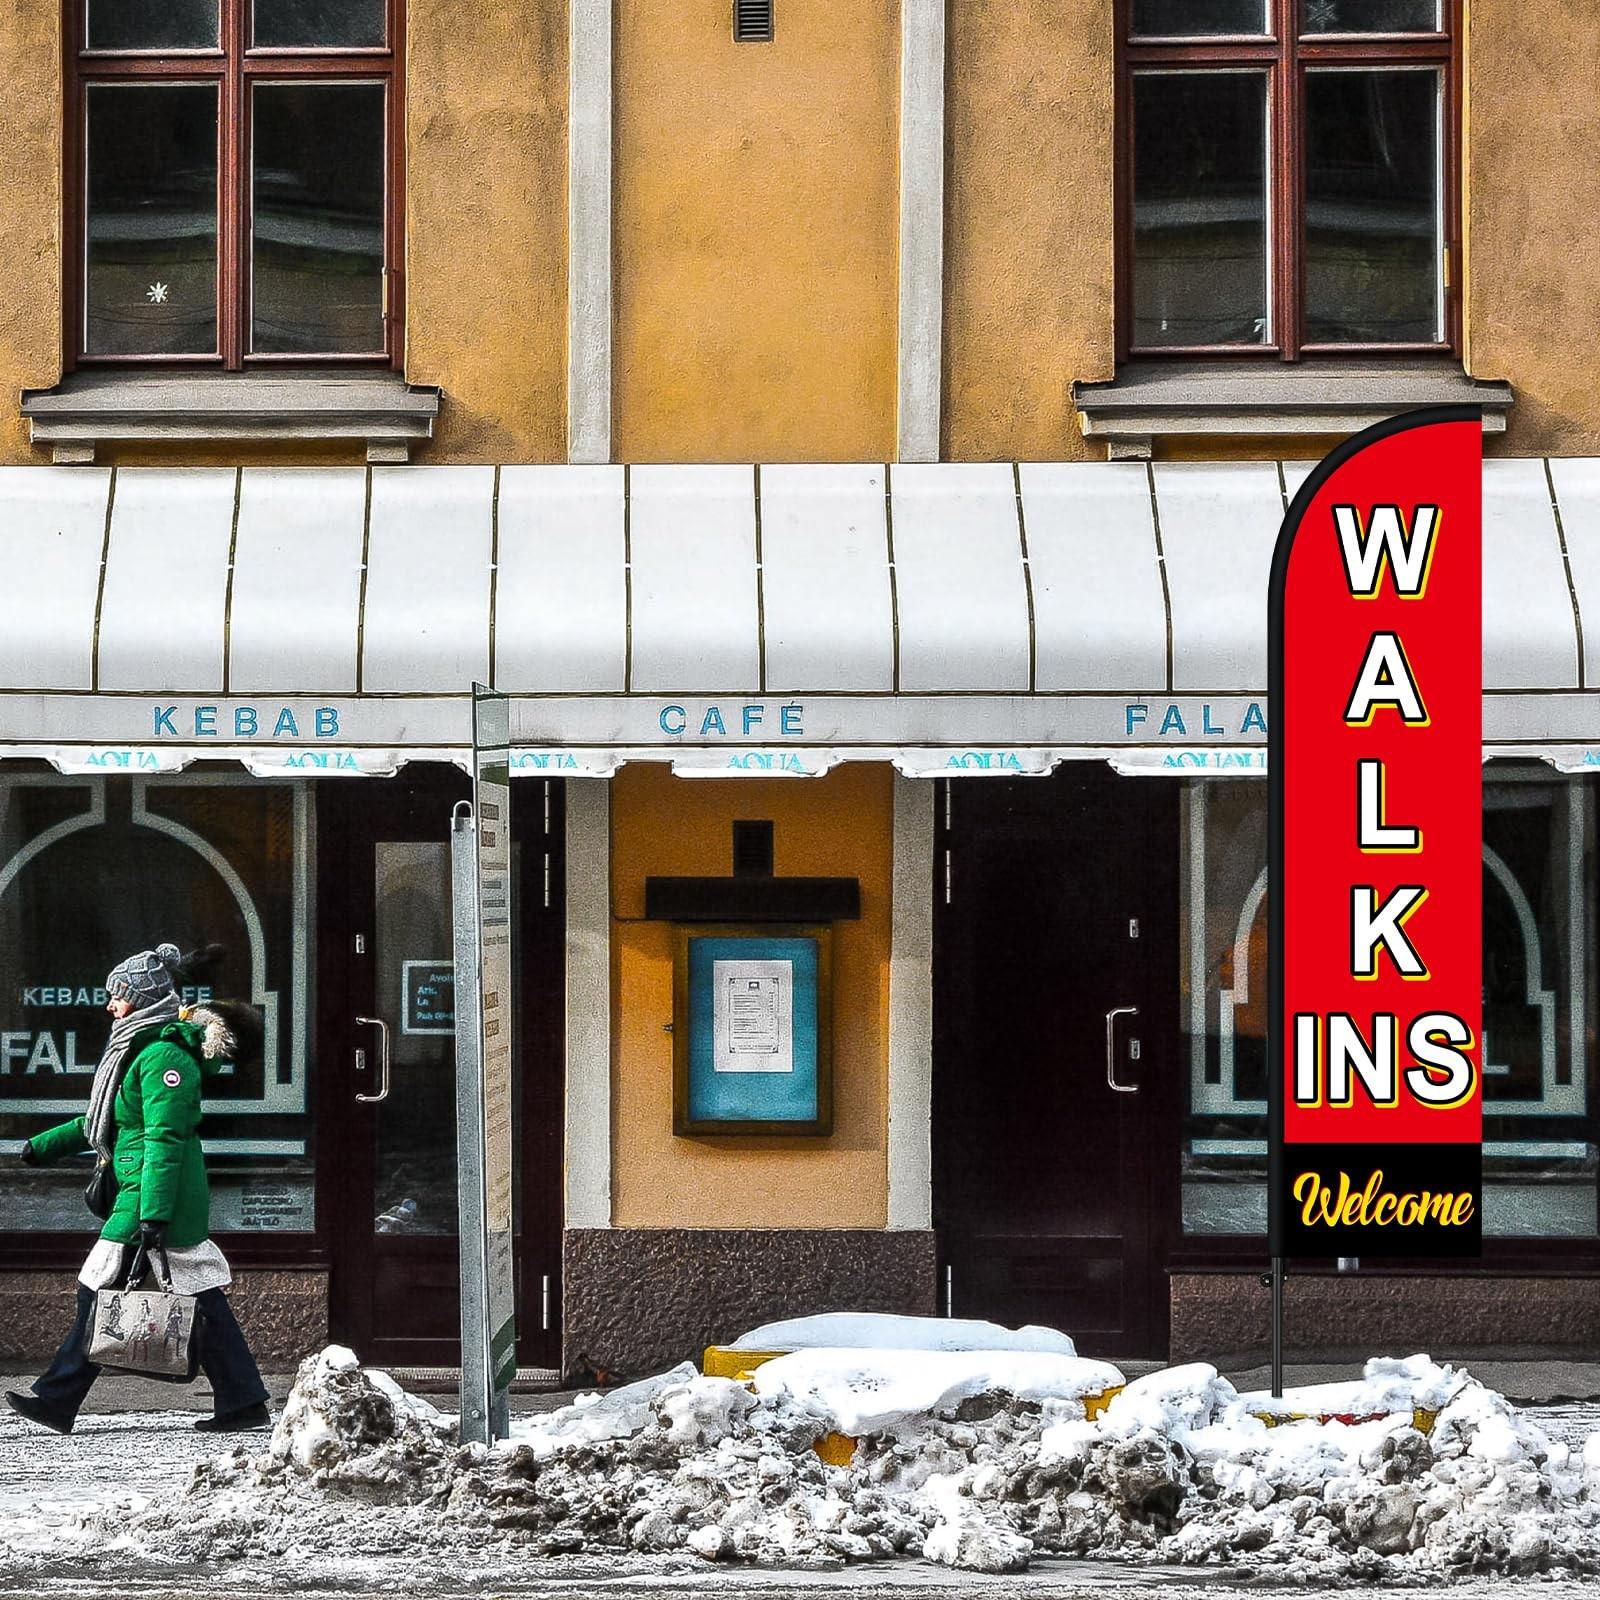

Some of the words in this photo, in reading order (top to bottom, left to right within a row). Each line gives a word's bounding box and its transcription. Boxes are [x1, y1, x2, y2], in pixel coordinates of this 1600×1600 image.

[153, 706, 340, 737] KEBAB
[660, 701, 804, 736] CAFÉ
[1125, 703, 1268, 736] FALA
[1331, 503, 1443, 983] WALK
[23, 986, 107, 1006] KEBAB
[1, 1031, 96, 1075] FAL
[1293, 1010, 1478, 1110] INS
[1293, 1169, 1475, 1228] Welcome
